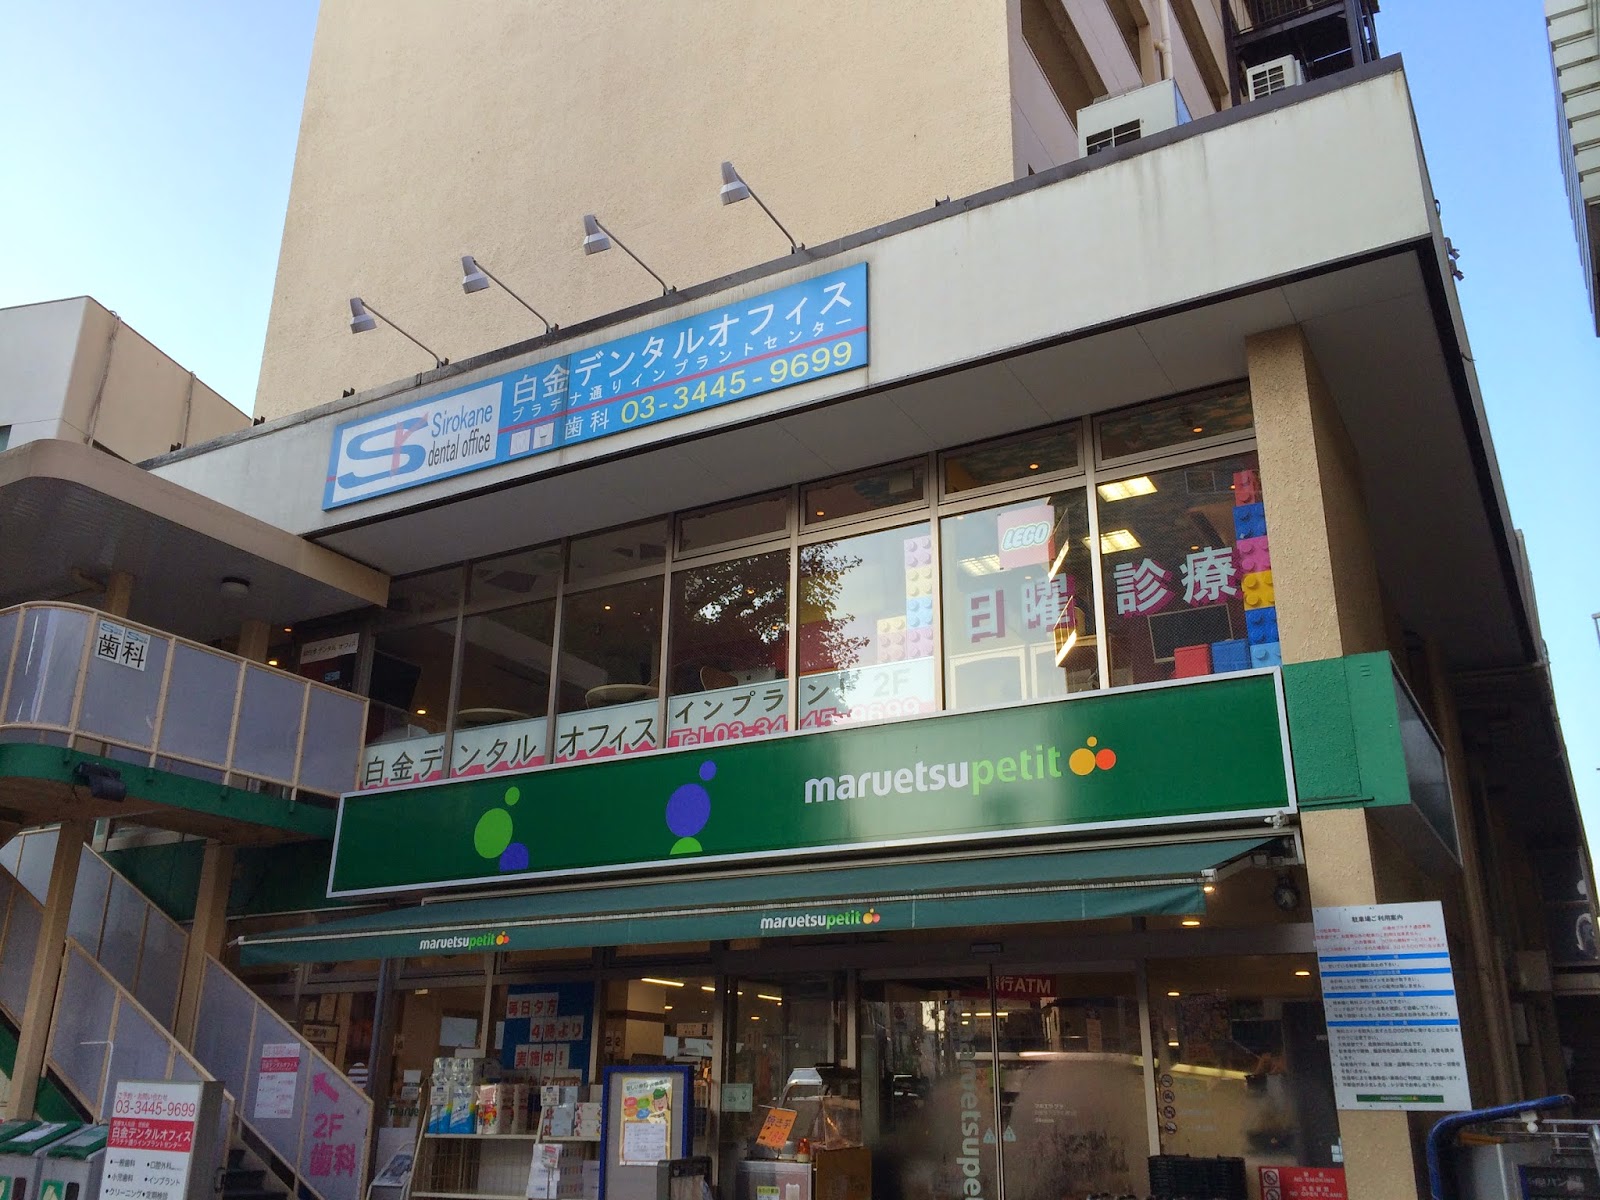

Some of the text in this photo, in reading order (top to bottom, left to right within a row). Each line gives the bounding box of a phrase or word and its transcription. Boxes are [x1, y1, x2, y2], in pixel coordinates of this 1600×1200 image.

[513, 281, 852, 407] 白金デンタルオフィス
[512, 318, 852, 422] プラチナ通りインプラントセンター
[620, 341, 852, 424] 03-3445-9699
[431, 404, 493, 438] Sirokane
[564, 408, 609, 440] 歯科
[427, 428, 491, 467] dental office
[1001, 521, 1050, 551] LEGO
[97, 633, 145, 668] 歯科
[804, 745, 1062, 804] maruetsupetit
[760, 908, 862, 930] maruetsupetit
[419, 931, 496, 951] maruetsupetit
[115, 1099, 196, 1118] 03-3445-9699
[111, 1127, 191, 1142] 白金デンタルオフィス
[312, 1113, 345, 1140] 2F
[309, 1143, 356, 1178] 歯科
